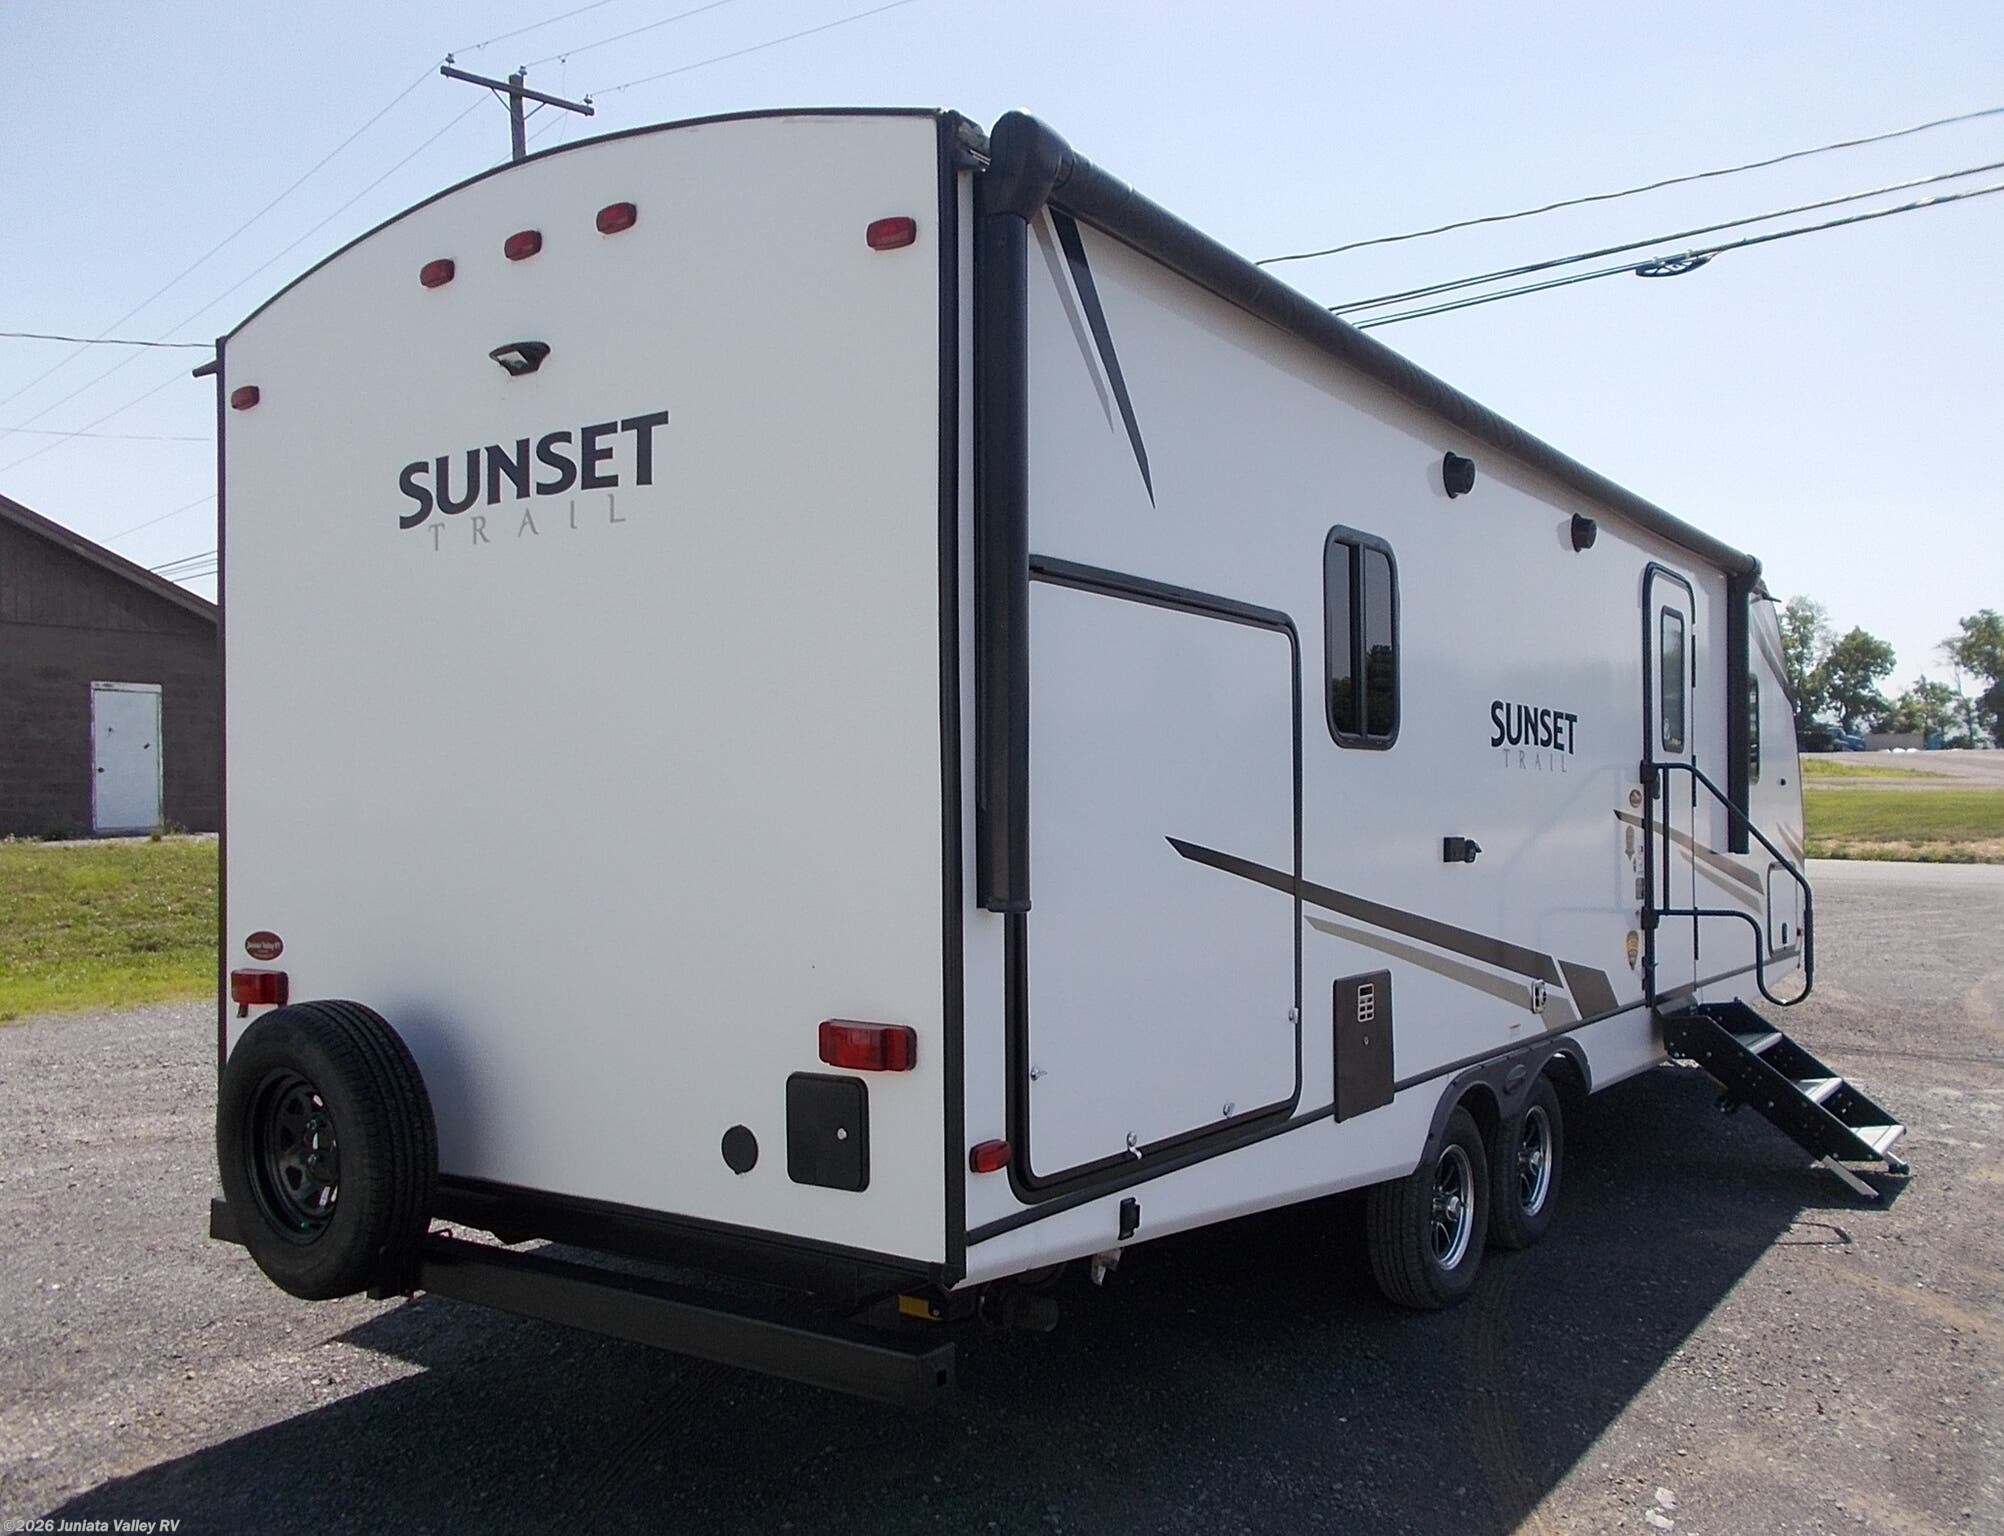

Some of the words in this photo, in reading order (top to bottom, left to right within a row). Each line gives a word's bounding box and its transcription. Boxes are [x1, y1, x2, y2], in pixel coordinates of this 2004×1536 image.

[399, 410, 669, 530] SUNSET
[427, 494, 626, 552] TRAIL
[1490, 700, 1578, 755] SUNSET
[1503, 748, 1567, 773] TRAIL
